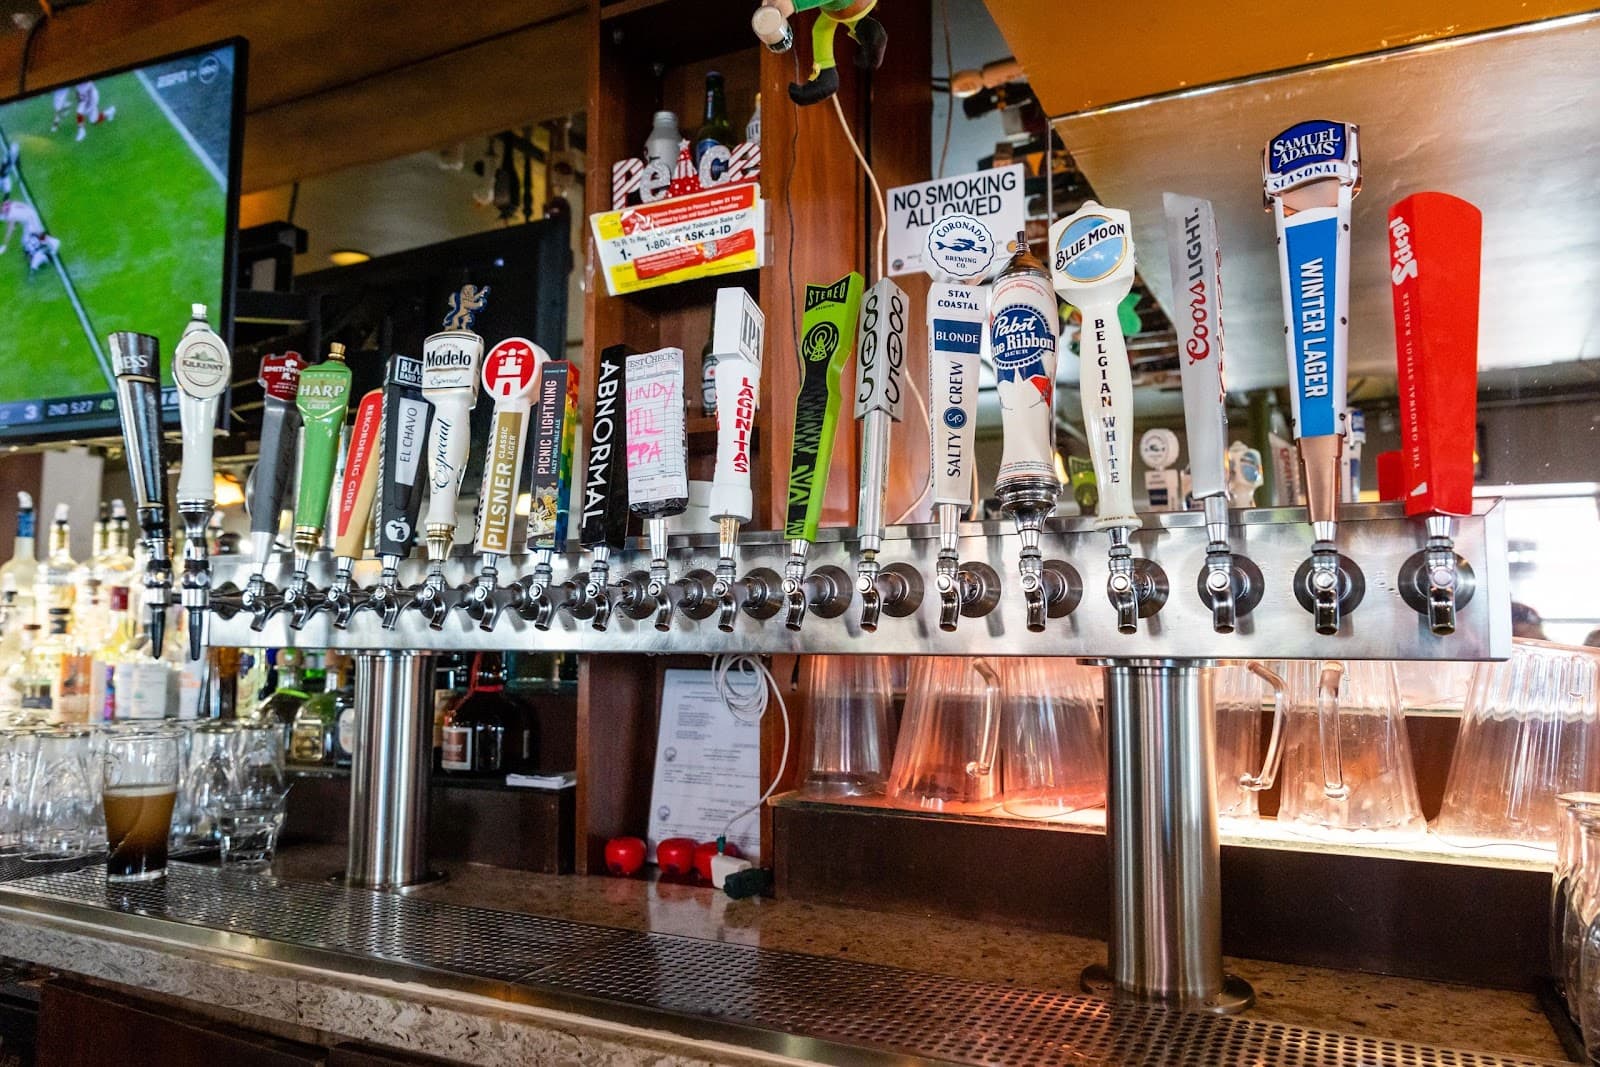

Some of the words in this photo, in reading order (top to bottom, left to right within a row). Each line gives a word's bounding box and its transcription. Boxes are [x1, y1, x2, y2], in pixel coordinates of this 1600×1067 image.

[1273, 128, 1341, 157] SAMUEL
[1277, 141, 1336, 168] ADAMS
[894, 190, 921, 211] NO
[926, 171, 1016, 205] SMOKING
[1273, 164, 1338, 189] SEASONAL
[936, 221, 986, 243] CORONADO
[1056, 238, 1086, 270] BLUE
[1088, 223, 1125, 246] MOON
[1390, 216, 1418, 286] Stiegl
[945, 255, 977, 264] BREWING
[808, 281, 846, 306] STEREO
[938, 299, 980, 311] COASTAL
[947, 289, 971, 299] STAY
[1300, 257, 1326, 333] WINTER
[742, 310, 761, 361] IPA
[935, 331, 979, 344] BLONDE
[995, 316, 1037, 339] Pabst
[1006, 332, 1054, 351] Ribbon
[1186, 280, 1210, 366] Coors
[182, 359, 225, 372] KILKENNY
[401, 360, 424, 374] BLA
[425, 350, 471, 368] Modelo
[859, 294, 879, 403] 805
[885, 295, 904, 404] 805
[1004, 349, 1028, 358] BEER
[1094, 318, 1112, 408] BELGIAN
[1303, 337, 1329, 398] LAGER
[300, 384, 345, 398] HARP
[949, 361, 964, 405] CREW
[541, 380, 557, 435] LIGHTNING
[733, 377, 754, 473] LAGUNITAS
[1409, 384, 1418, 441] ORIGINAL
[351, 404, 374, 477] REKORDERLIG
[402, 406, 418, 450] CHAVO
[498, 426, 508, 459] CLASSIC
[582, 360, 620, 528] ABNORMAL
[400, 453, 410, 463] EL
[432, 417, 453, 494] Especial
[507, 435, 516, 460] LAGER
[537, 439, 552, 475] PICNIC
[947, 431, 961, 478] SALTY
[1102, 416, 1120, 484] WHITE
[344, 480, 357, 513] CIDER
[487, 462, 512, 546] PILSNER
